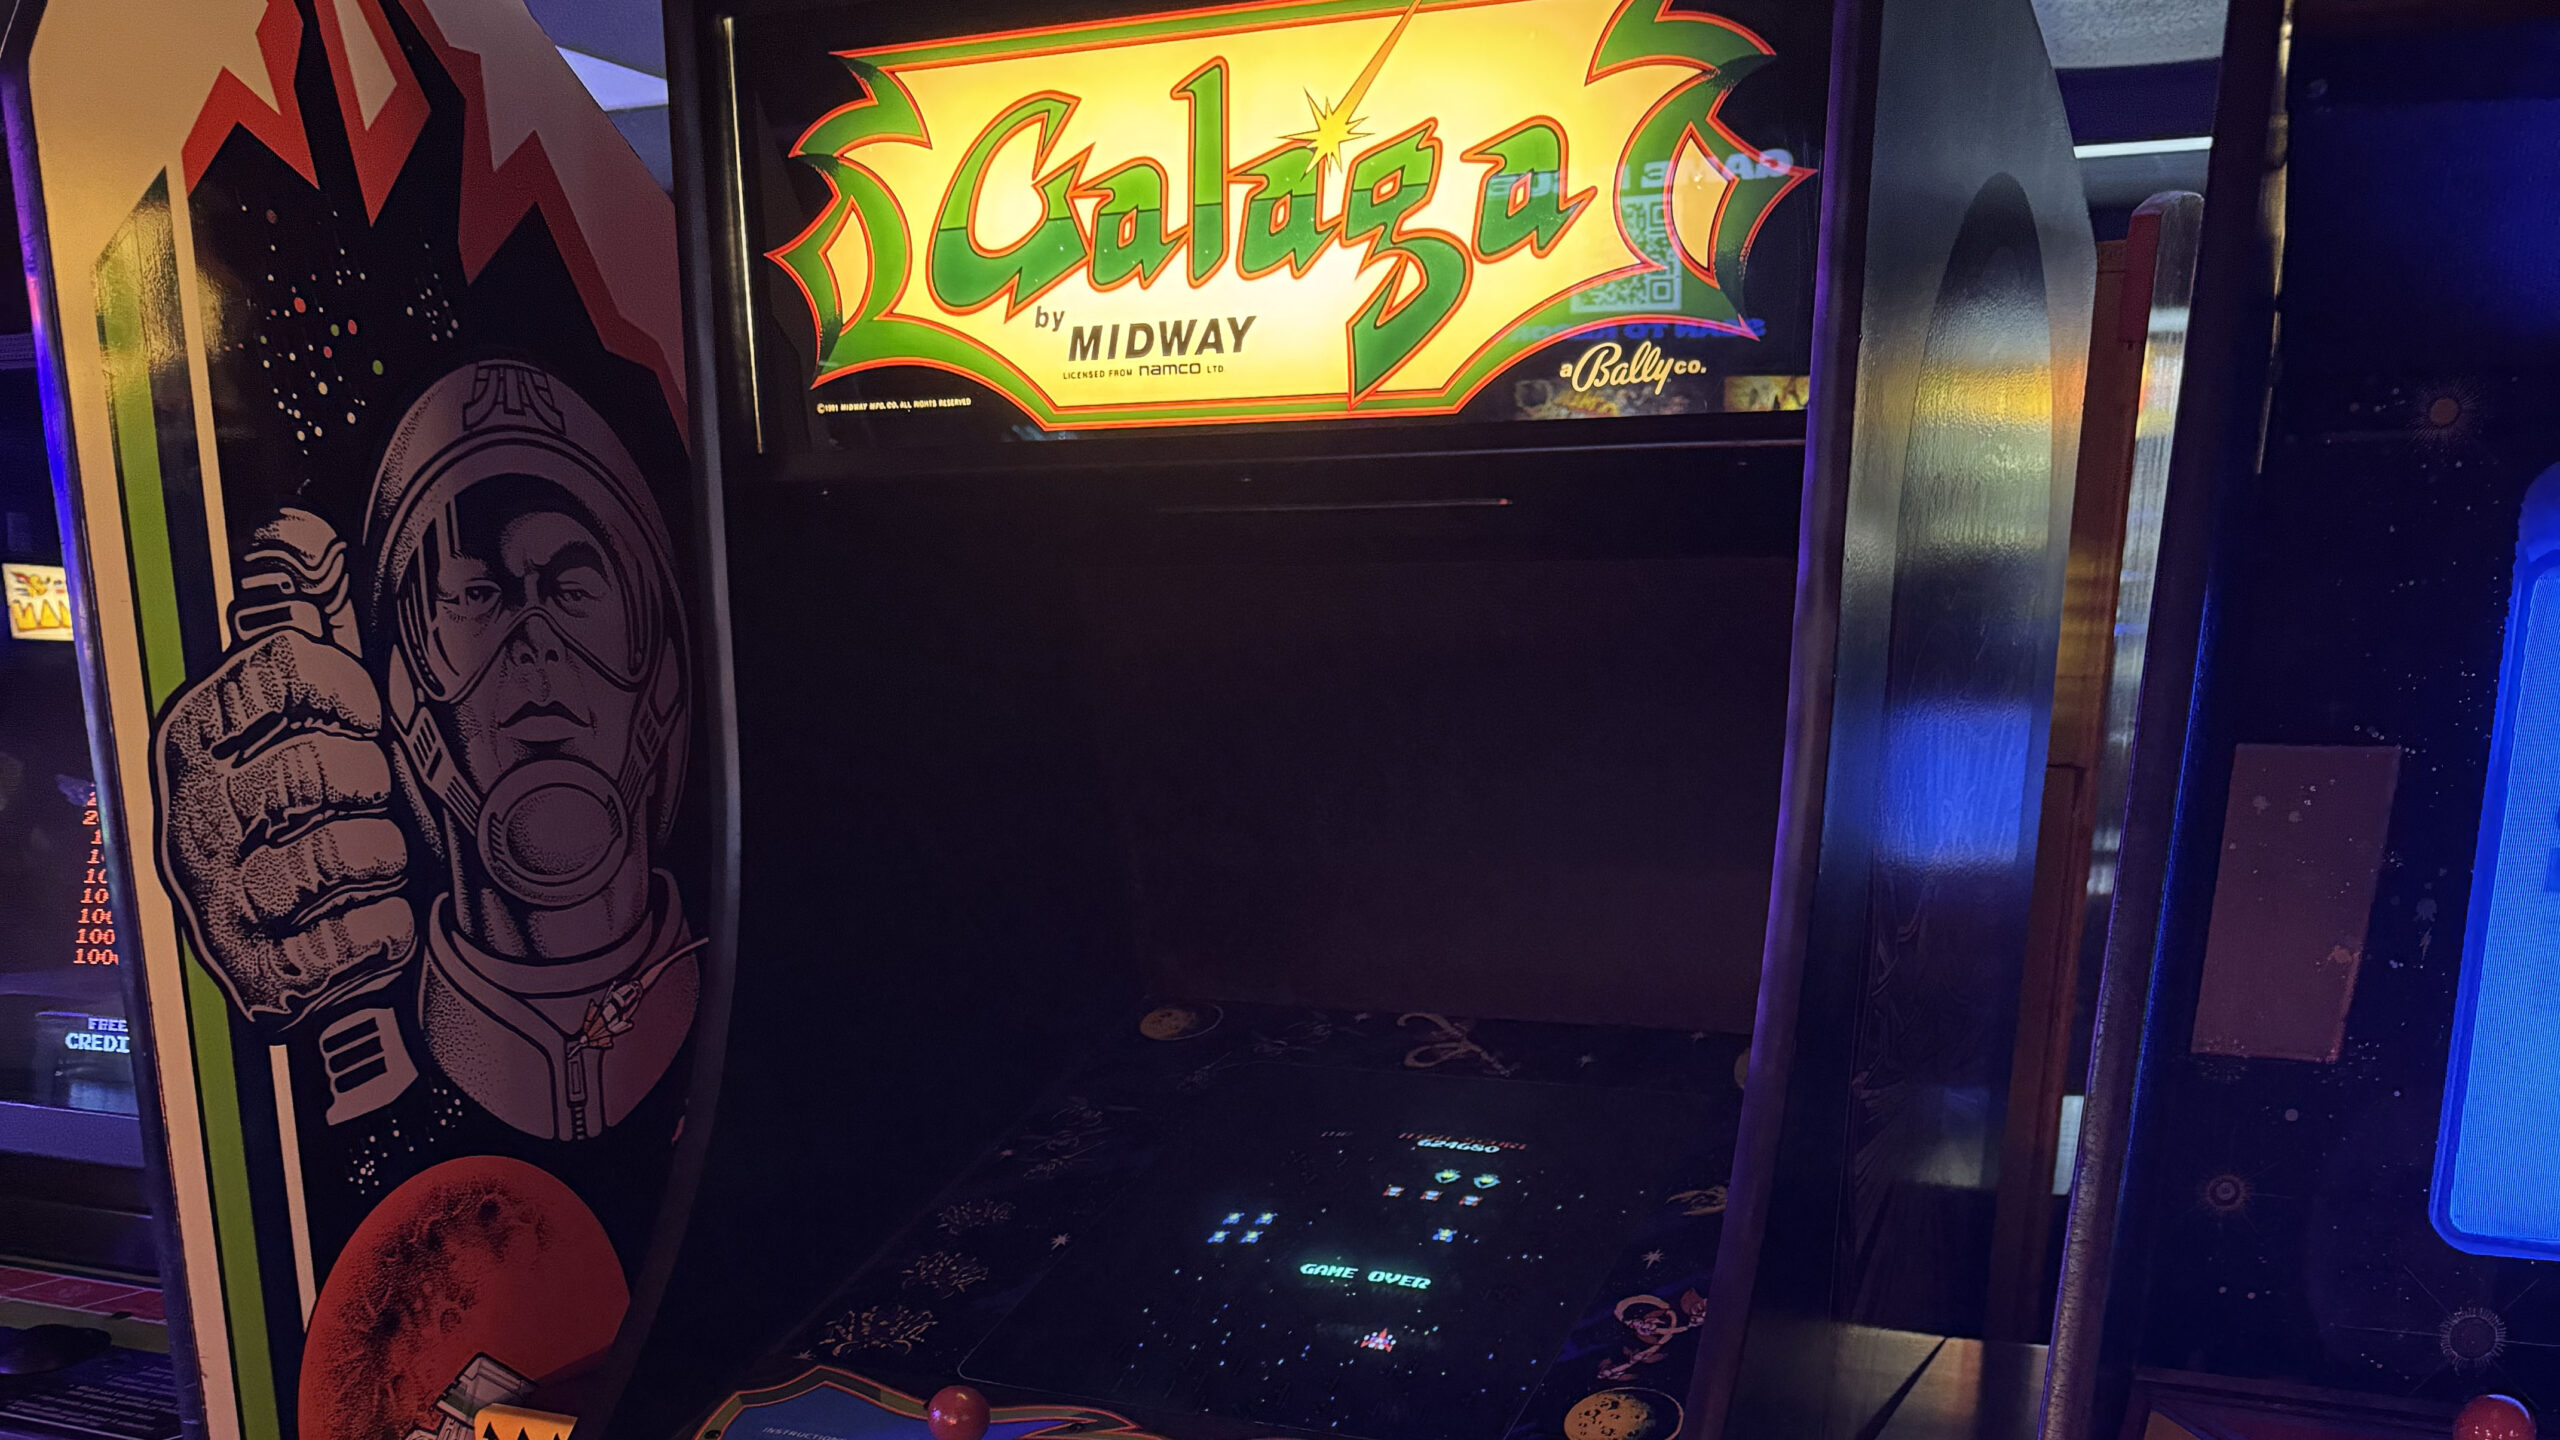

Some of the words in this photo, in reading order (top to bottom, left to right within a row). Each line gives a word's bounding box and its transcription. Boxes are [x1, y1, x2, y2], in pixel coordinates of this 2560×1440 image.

[926, 56, 1597, 410] Galaga
[1035, 306, 1065, 332] by
[1068, 316, 1257, 361] MIDWAY
[1063, 370, 1105, 380] LICENSED
[1108, 369, 1132, 378] FROM
[1139, 363, 1200, 377] namco
[1559, 363, 1573, 378] a
[1572, 340, 1674, 395] Bally
[1674, 360, 1707, 375] co.
[840, 402, 868, 412] MIDWAY
[913, 399, 937, 408] RIGHTS
[938, 397, 972, 407] RESERVED
[82, 810, 99, 825] 2
[87, 848, 105, 864] 1
[88, 1017, 128, 1032] FREE
[65, 1032, 130, 1053] CREDI
[1300, 1263, 1358, 1279] GAME
[1367, 1270, 1431, 1289] OVER
[762, 1427, 848, 1440] INSTRUCTION
